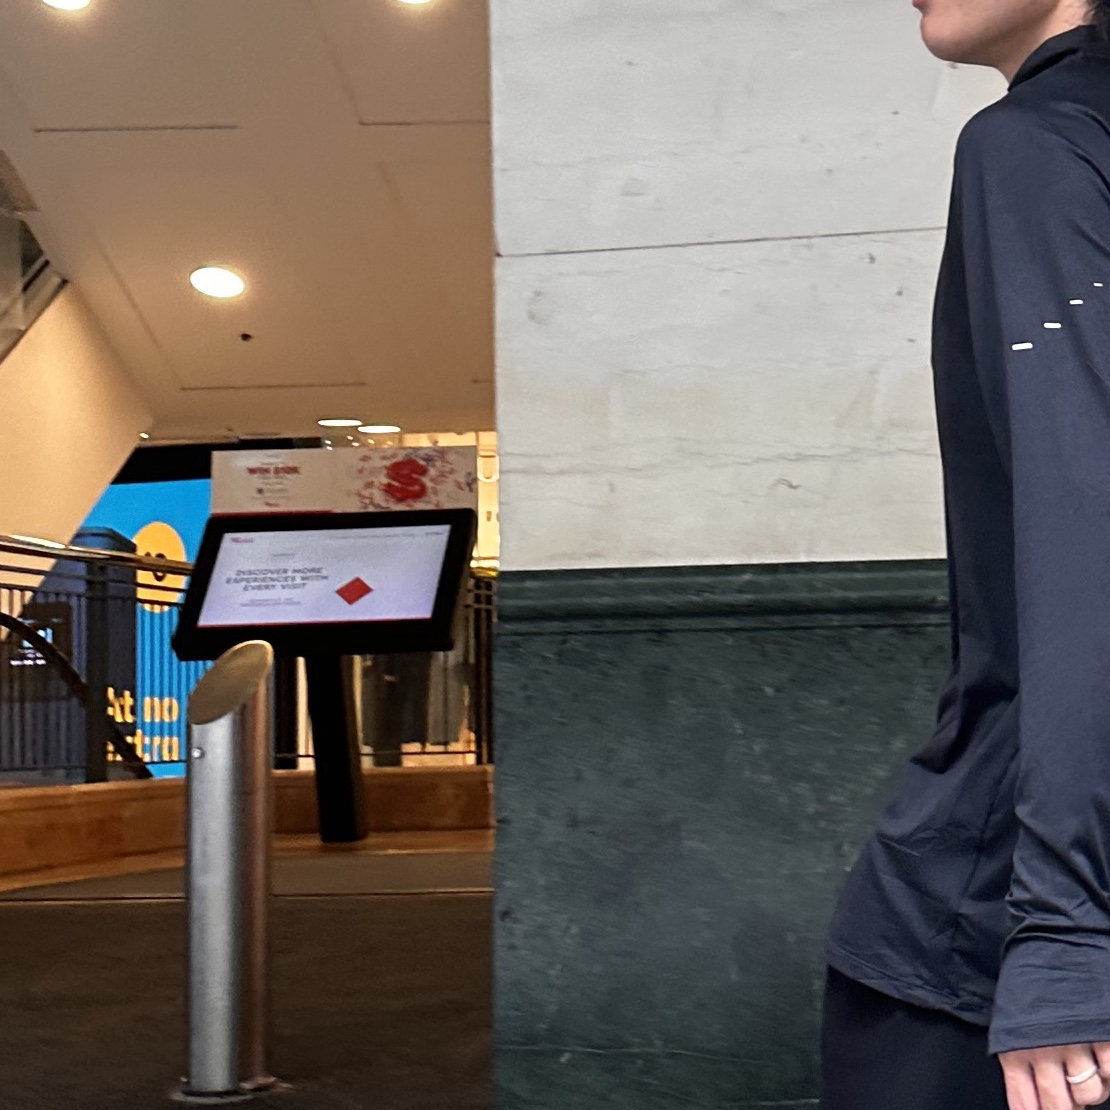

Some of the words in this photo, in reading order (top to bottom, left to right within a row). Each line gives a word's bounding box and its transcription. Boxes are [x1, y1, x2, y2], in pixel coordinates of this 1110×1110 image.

[235, 568, 289, 576] DISCOVER
[291, 566, 323, 574] MORE
[225, 575, 296, 585] EXPERIENCES
[243, 584, 276, 592] EVERY
[280, 582, 307, 590] VISIT
[143, 696, 179, 723] no
